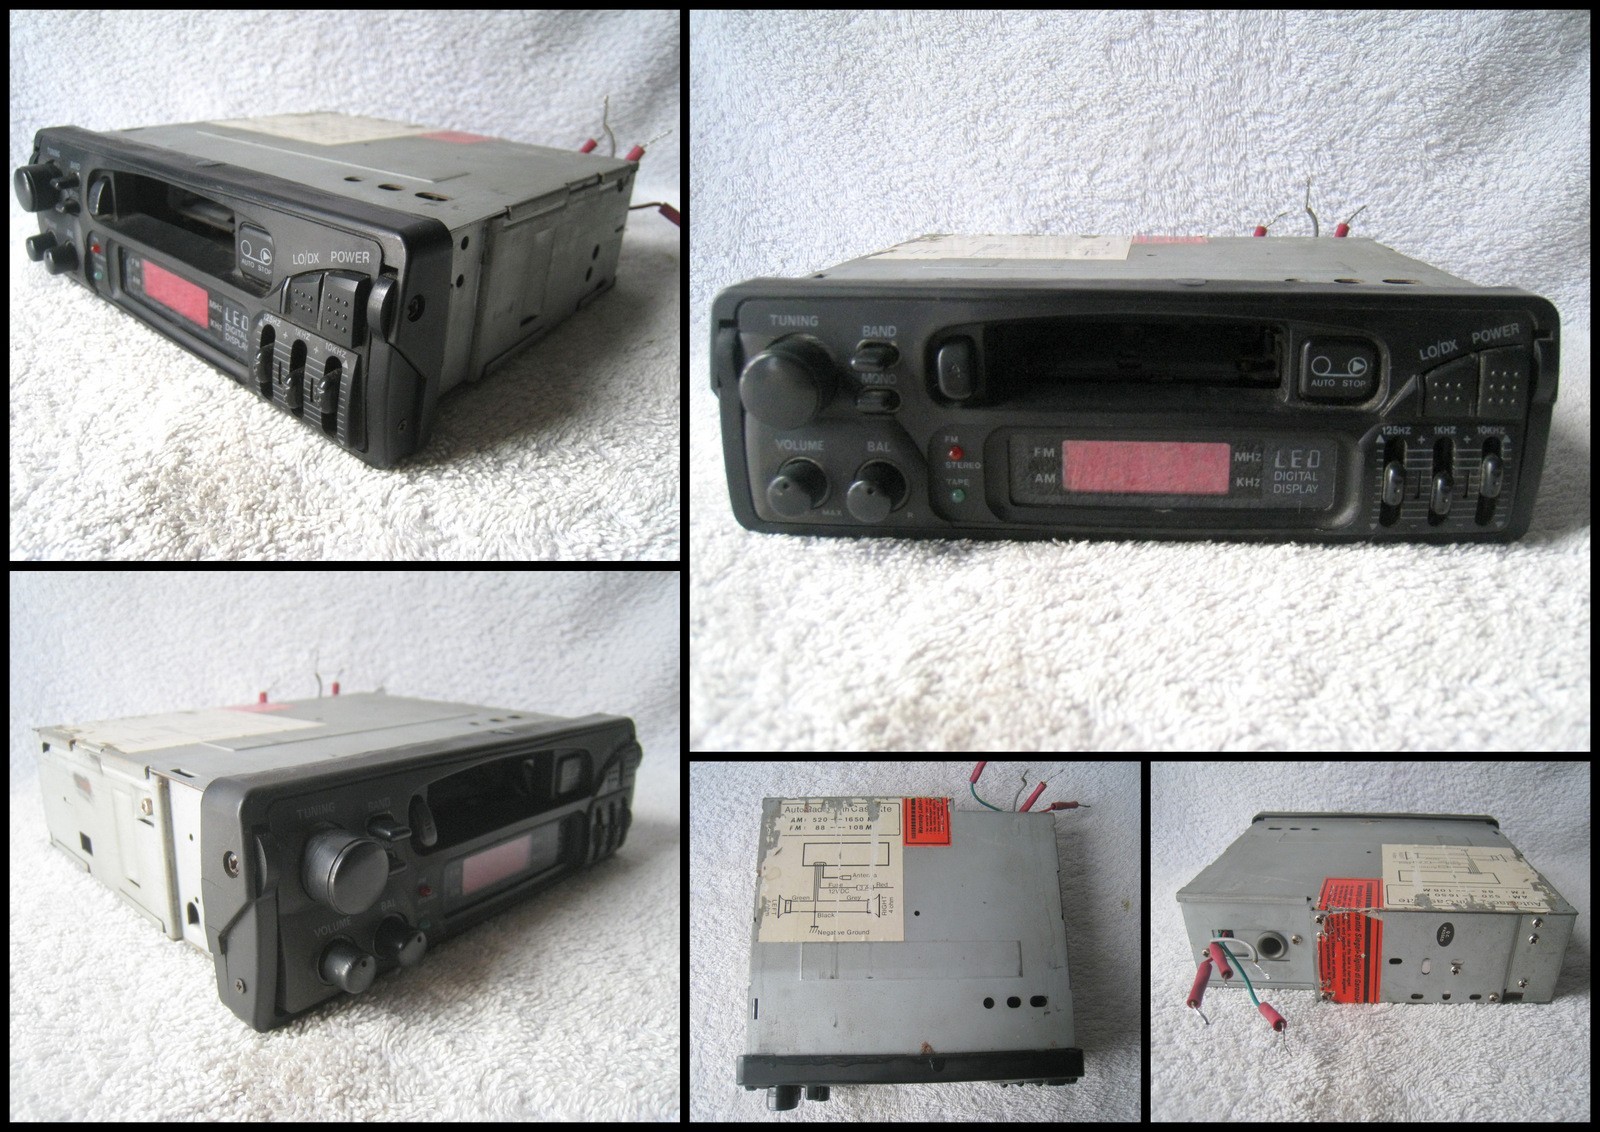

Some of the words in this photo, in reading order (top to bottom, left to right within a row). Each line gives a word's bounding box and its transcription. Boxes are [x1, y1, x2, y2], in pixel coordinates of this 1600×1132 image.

[292, 250, 320, 266] LO/DX
[330, 251, 370, 264] POWER
[241, 258, 255, 269] AUTO
[257, 265, 272, 275] STOP
[225, 306, 249, 331] LED
[770, 314, 819, 327] TUNING
[225, 322, 248, 342] DIGITAL
[862, 325, 897, 338] BAND
[1471, 322, 1520, 344] POWER
[325, 342, 347, 358] 10KHZ
[1419, 340, 1459, 361] LO/DX
[861, 372, 897, 385] MONO
[1311, 379, 1335, 387] AUTO
[1342, 379, 1366, 387] STOP
[1382, 426, 1412, 435] 125HZ
[1434, 426, 1457, 435] 1KHZ
[1477, 426, 1505, 435] 10KHZ
[944, 435, 959, 443] FM
[775, 439, 824, 451] VOLUME
[867, 441, 891, 452] BAL
[1034, 447, 1055, 458] FM
[1234, 451, 1262, 463] MHz
[1274, 450, 1321, 468] LED
[945, 461, 981, 470] STEREO
[1034, 473, 1056, 484] AM
[1274, 471, 1318, 482] DIGITAL
[946, 478, 969, 487] TAPE
[1236, 477, 1261, 488] KHz
[1273, 484, 1318, 495] DISPLAY
[296, 802, 336, 819] TUNING
[785, 804, 804, 814] Auto
[851, 803, 892, 813] Caste
[381, 900, 398, 911] BAL
[313, 917, 351, 938] VOLUME
